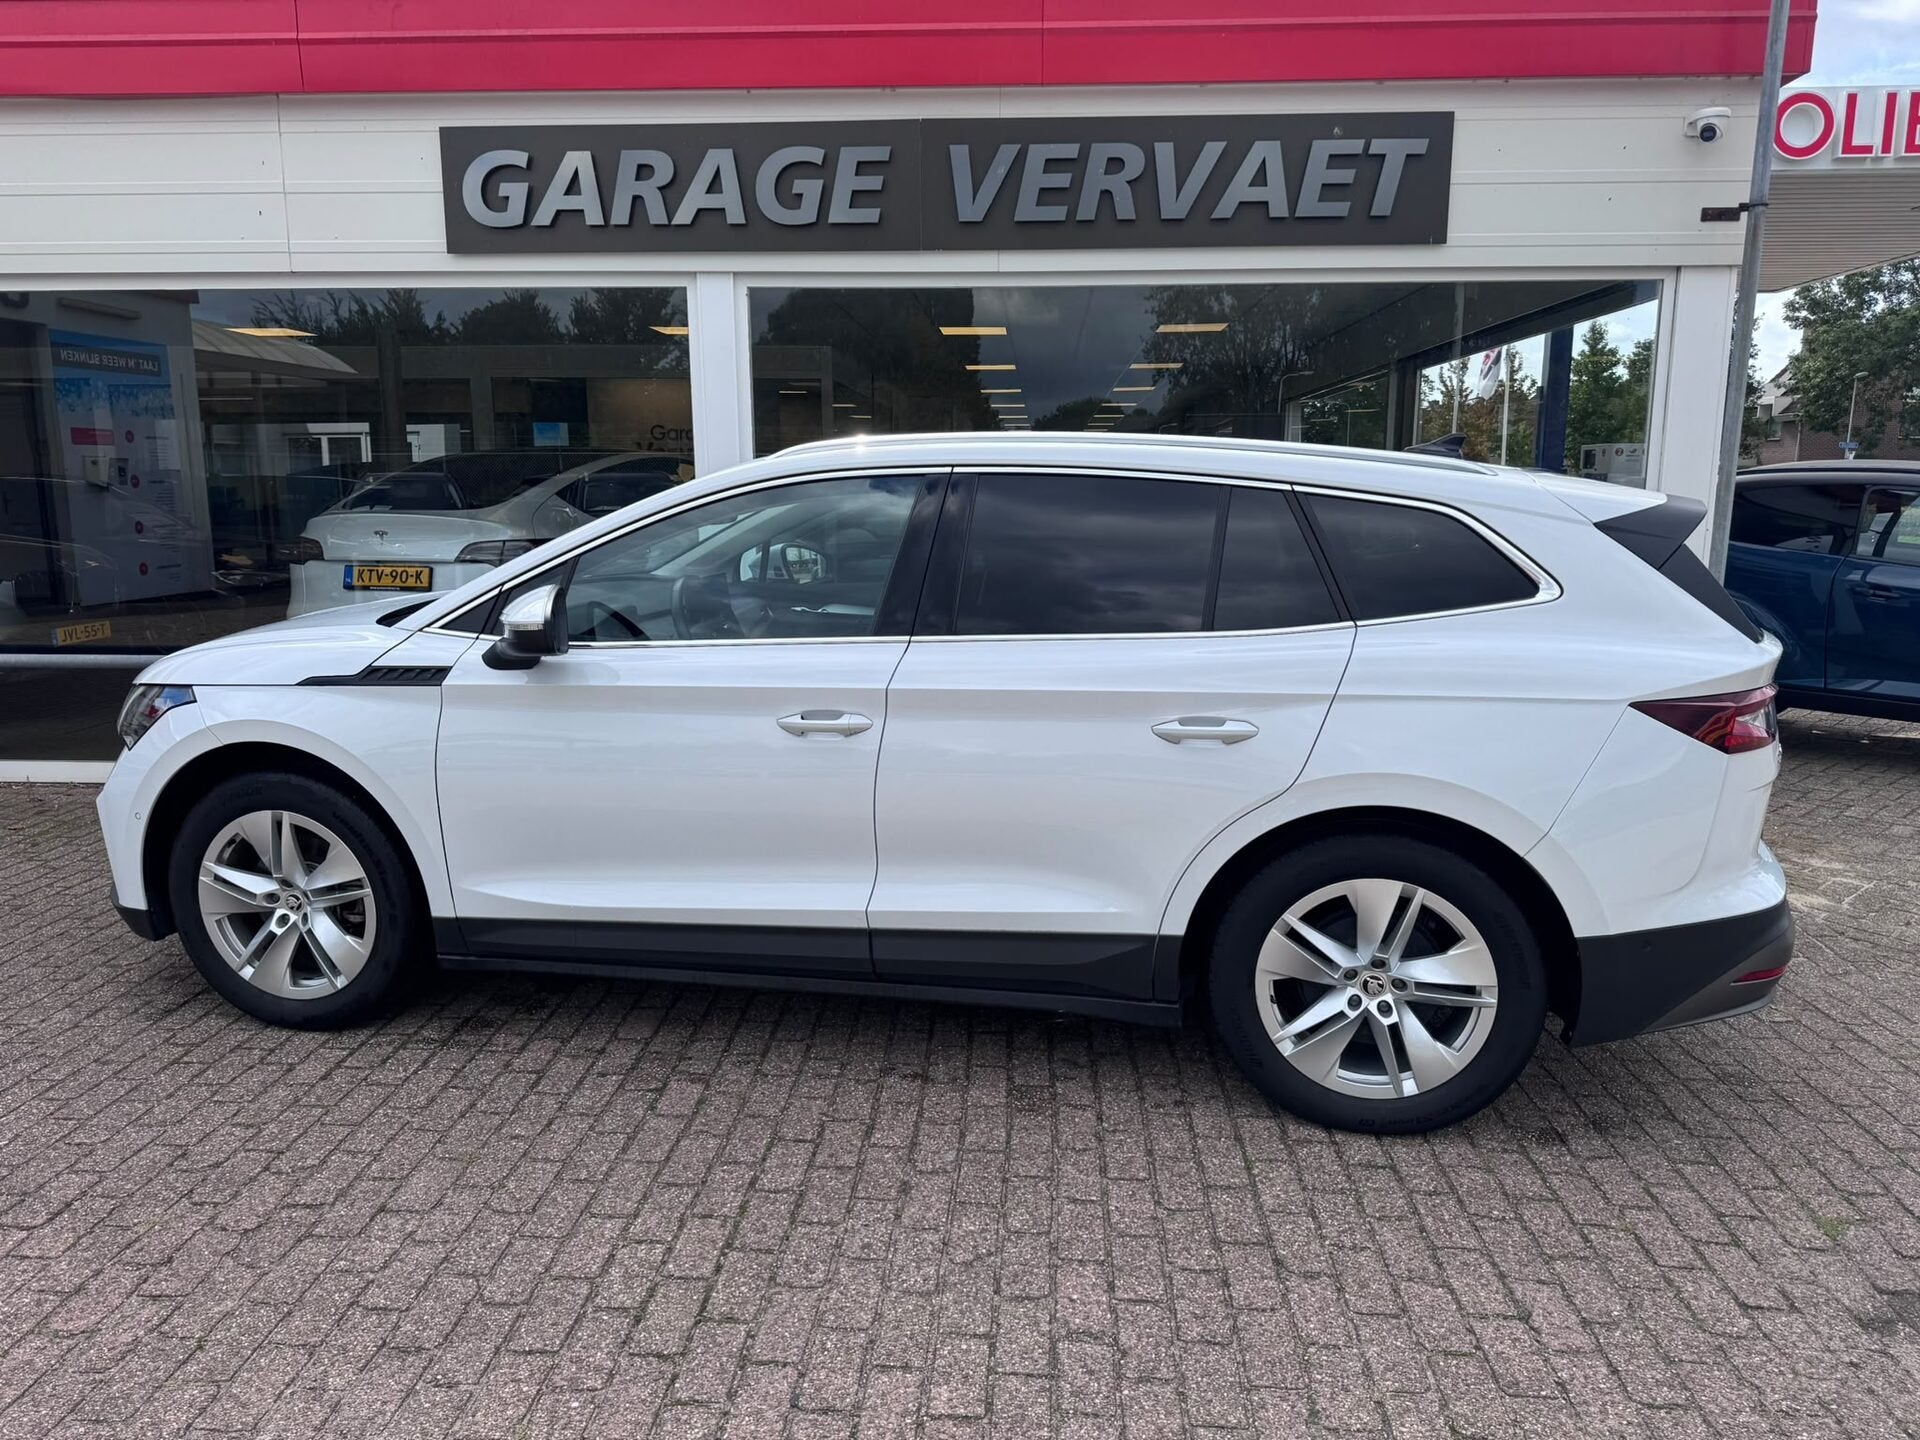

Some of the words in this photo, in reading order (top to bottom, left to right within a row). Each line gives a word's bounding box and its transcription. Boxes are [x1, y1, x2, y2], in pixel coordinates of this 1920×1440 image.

[462, 145, 892, 229] GARAGE
[949, 138, 1430, 222] VERVAET
[356, 568, 425, 585] KTV-90-K
[61, 623, 107, 643] JVL-55-T
